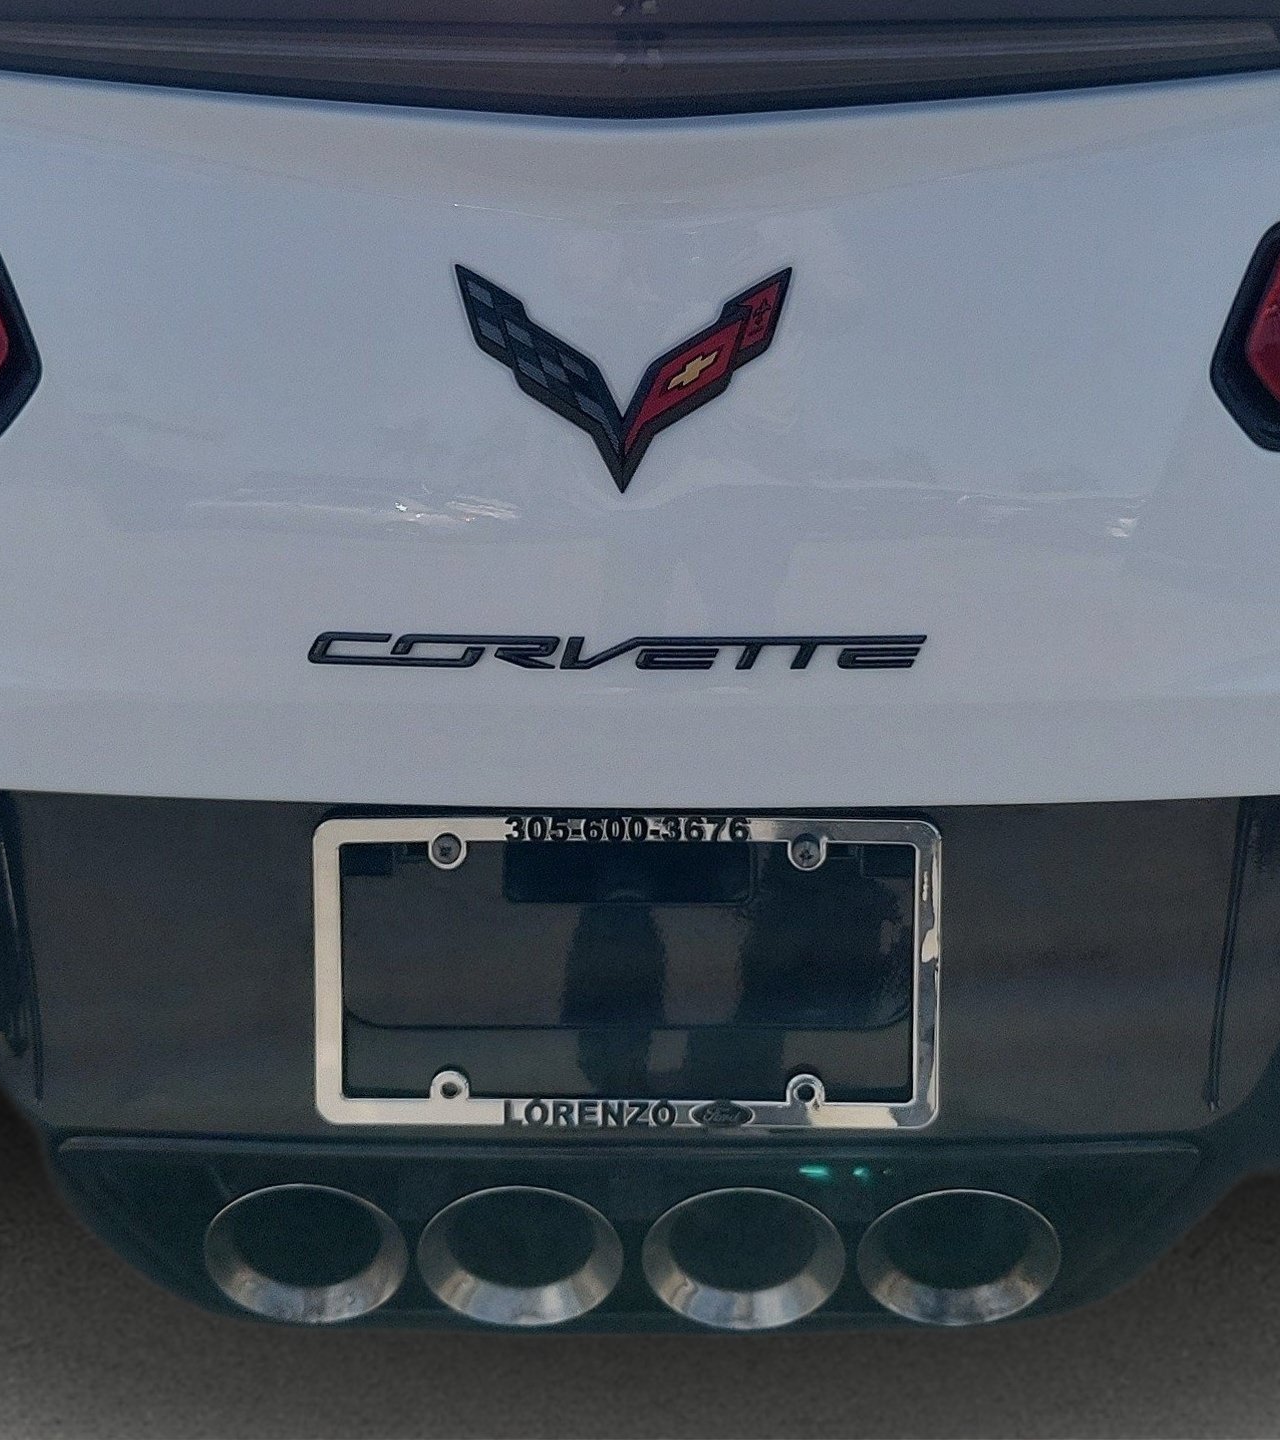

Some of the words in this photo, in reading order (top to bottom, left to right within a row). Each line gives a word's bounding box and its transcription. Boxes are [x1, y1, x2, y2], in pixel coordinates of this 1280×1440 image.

[308, 631, 928, 671] CORVETTE
[504, 815, 753, 842] 305-600-3676
[504, 1098, 677, 1128] LORENZO
